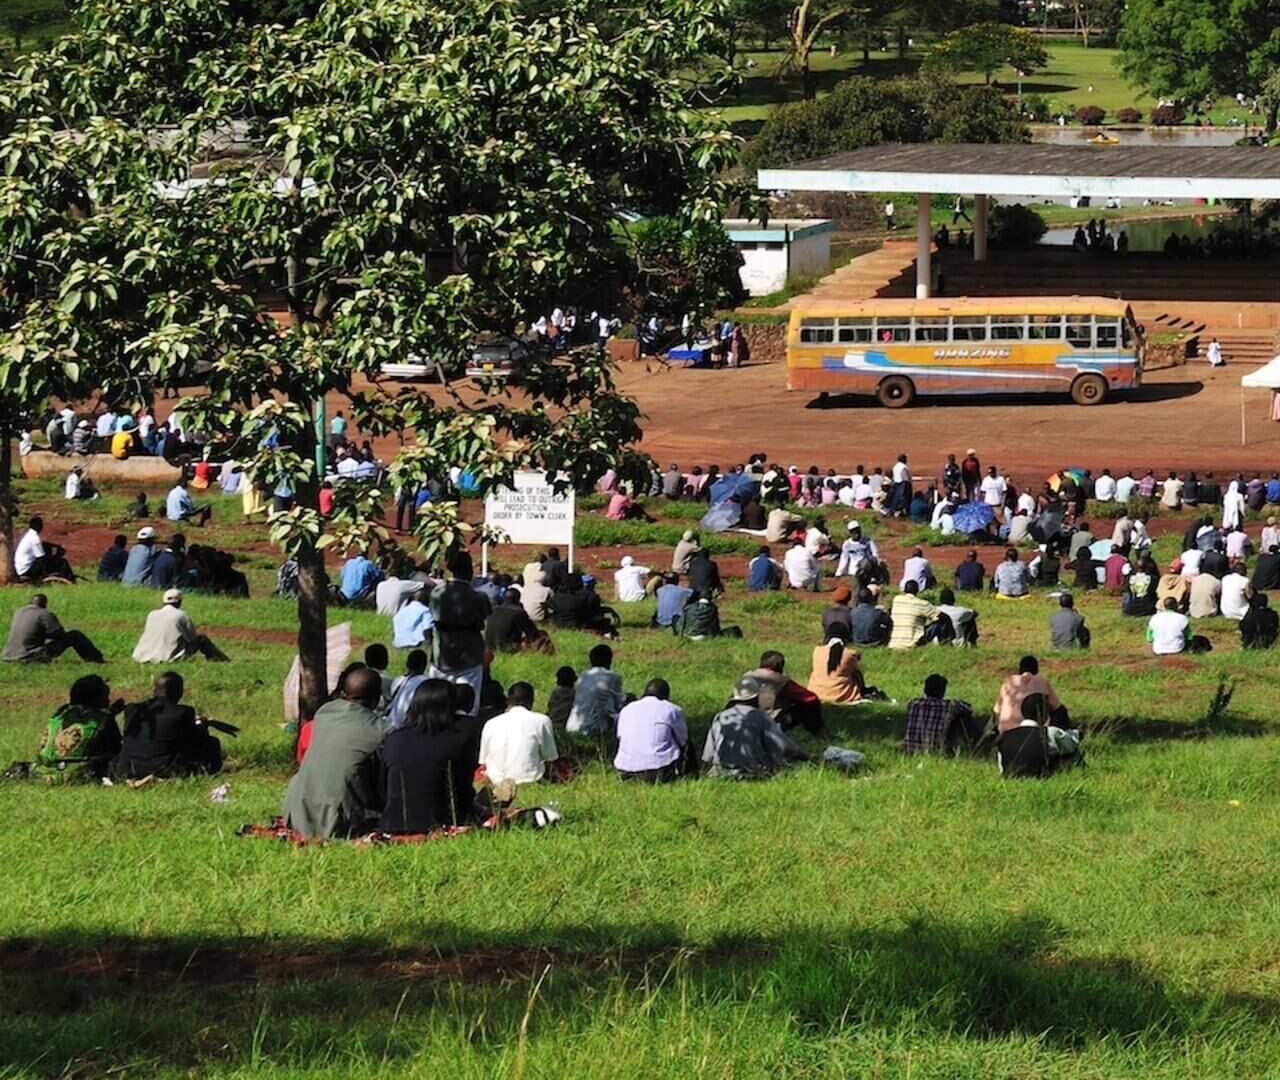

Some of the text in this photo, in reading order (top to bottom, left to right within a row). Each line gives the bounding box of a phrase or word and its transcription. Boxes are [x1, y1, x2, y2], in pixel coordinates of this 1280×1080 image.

[934, 347, 1011, 358] AMAZING
[510, 495, 524, 503] LEAD
[528, 495, 537, 503] TO
[504, 503, 548, 511] PROSECUTION
[493, 511, 567, 520] ORDER BY TOWN CLERK
